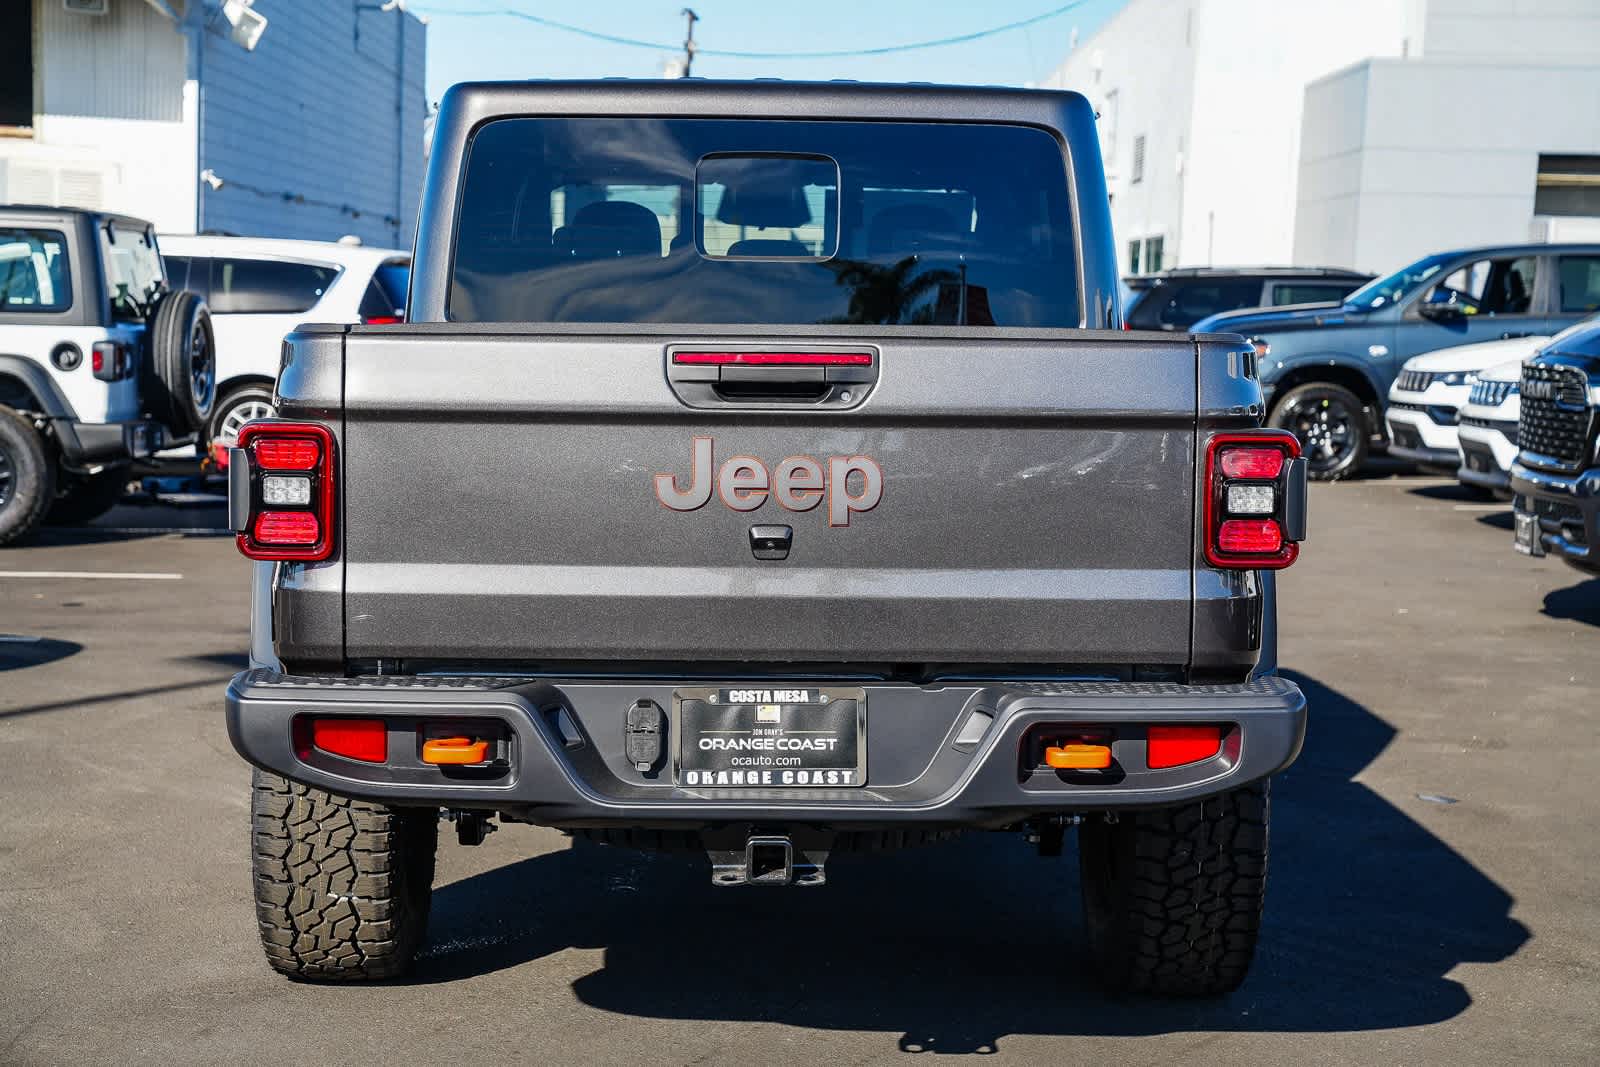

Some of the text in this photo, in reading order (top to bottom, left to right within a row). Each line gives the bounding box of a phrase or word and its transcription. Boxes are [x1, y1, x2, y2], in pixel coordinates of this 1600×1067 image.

[655, 436, 884, 528] Jeep
[729, 690, 809, 703] COSTA MESA
[699, 738, 838, 750] ORANGE COAST
[731, 755, 801, 766] ocauto.com
[686, 771, 853, 785] ORANGE COAST
